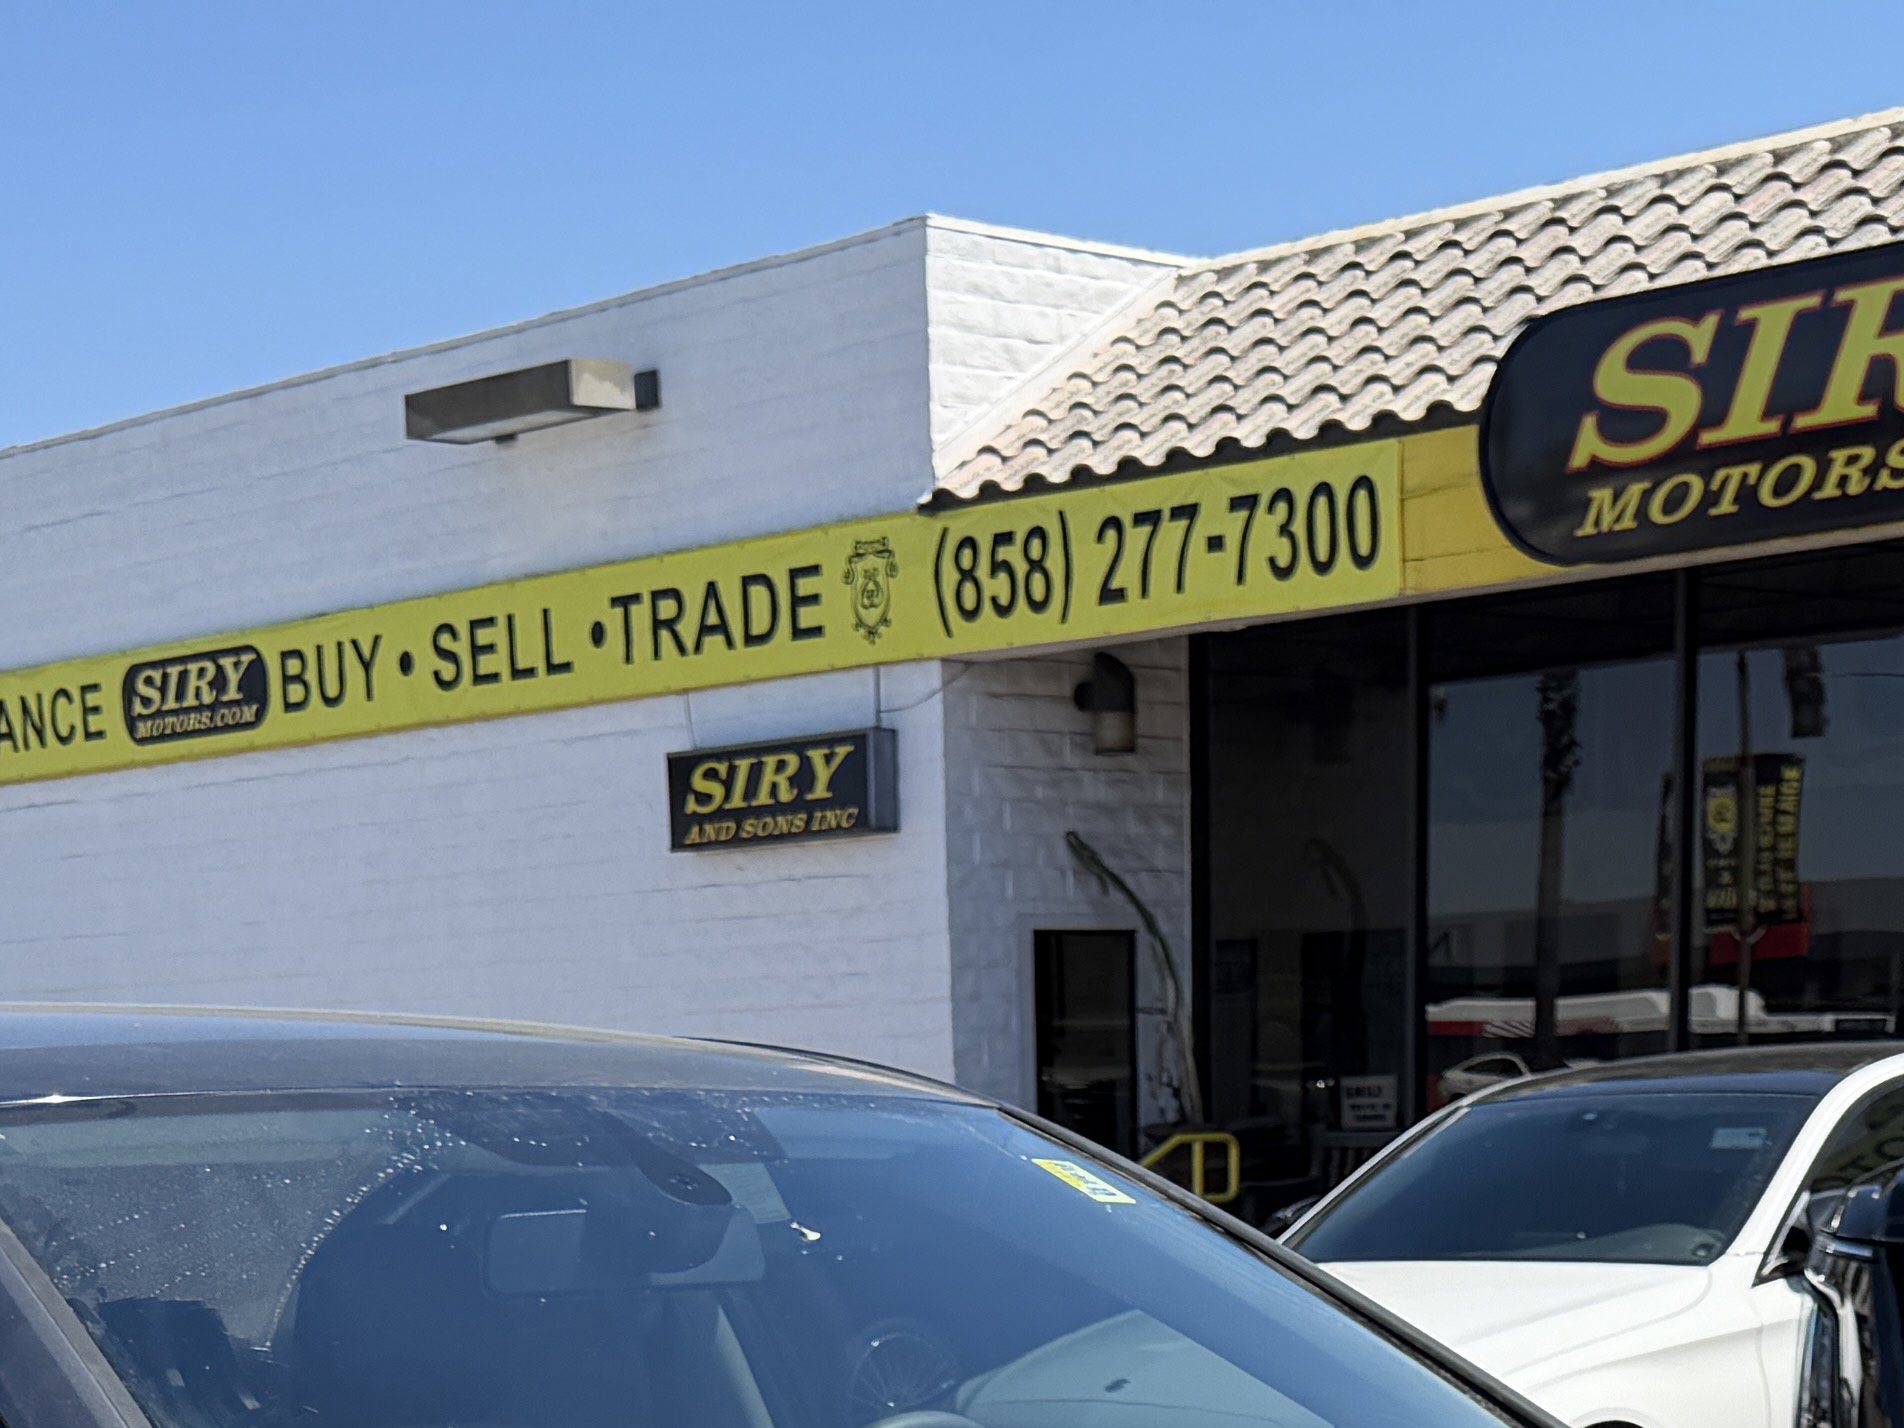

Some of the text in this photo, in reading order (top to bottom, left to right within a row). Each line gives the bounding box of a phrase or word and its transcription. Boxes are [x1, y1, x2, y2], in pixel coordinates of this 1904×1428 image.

[934, 509, 1073, 638] (858)
[1096, 475, 1380, 606] 277-7300
[279, 634, 383, 714] BUY
[431, 607, 575, 692] SELL
[611, 563, 825, 665] TRADE
[131, 653, 257, 717] SIRY
[135, 703, 259, 740] MOTORS.COM
[684, 745, 855, 815] SIRY
[683, 806, 860, 845] AND SONS INC
